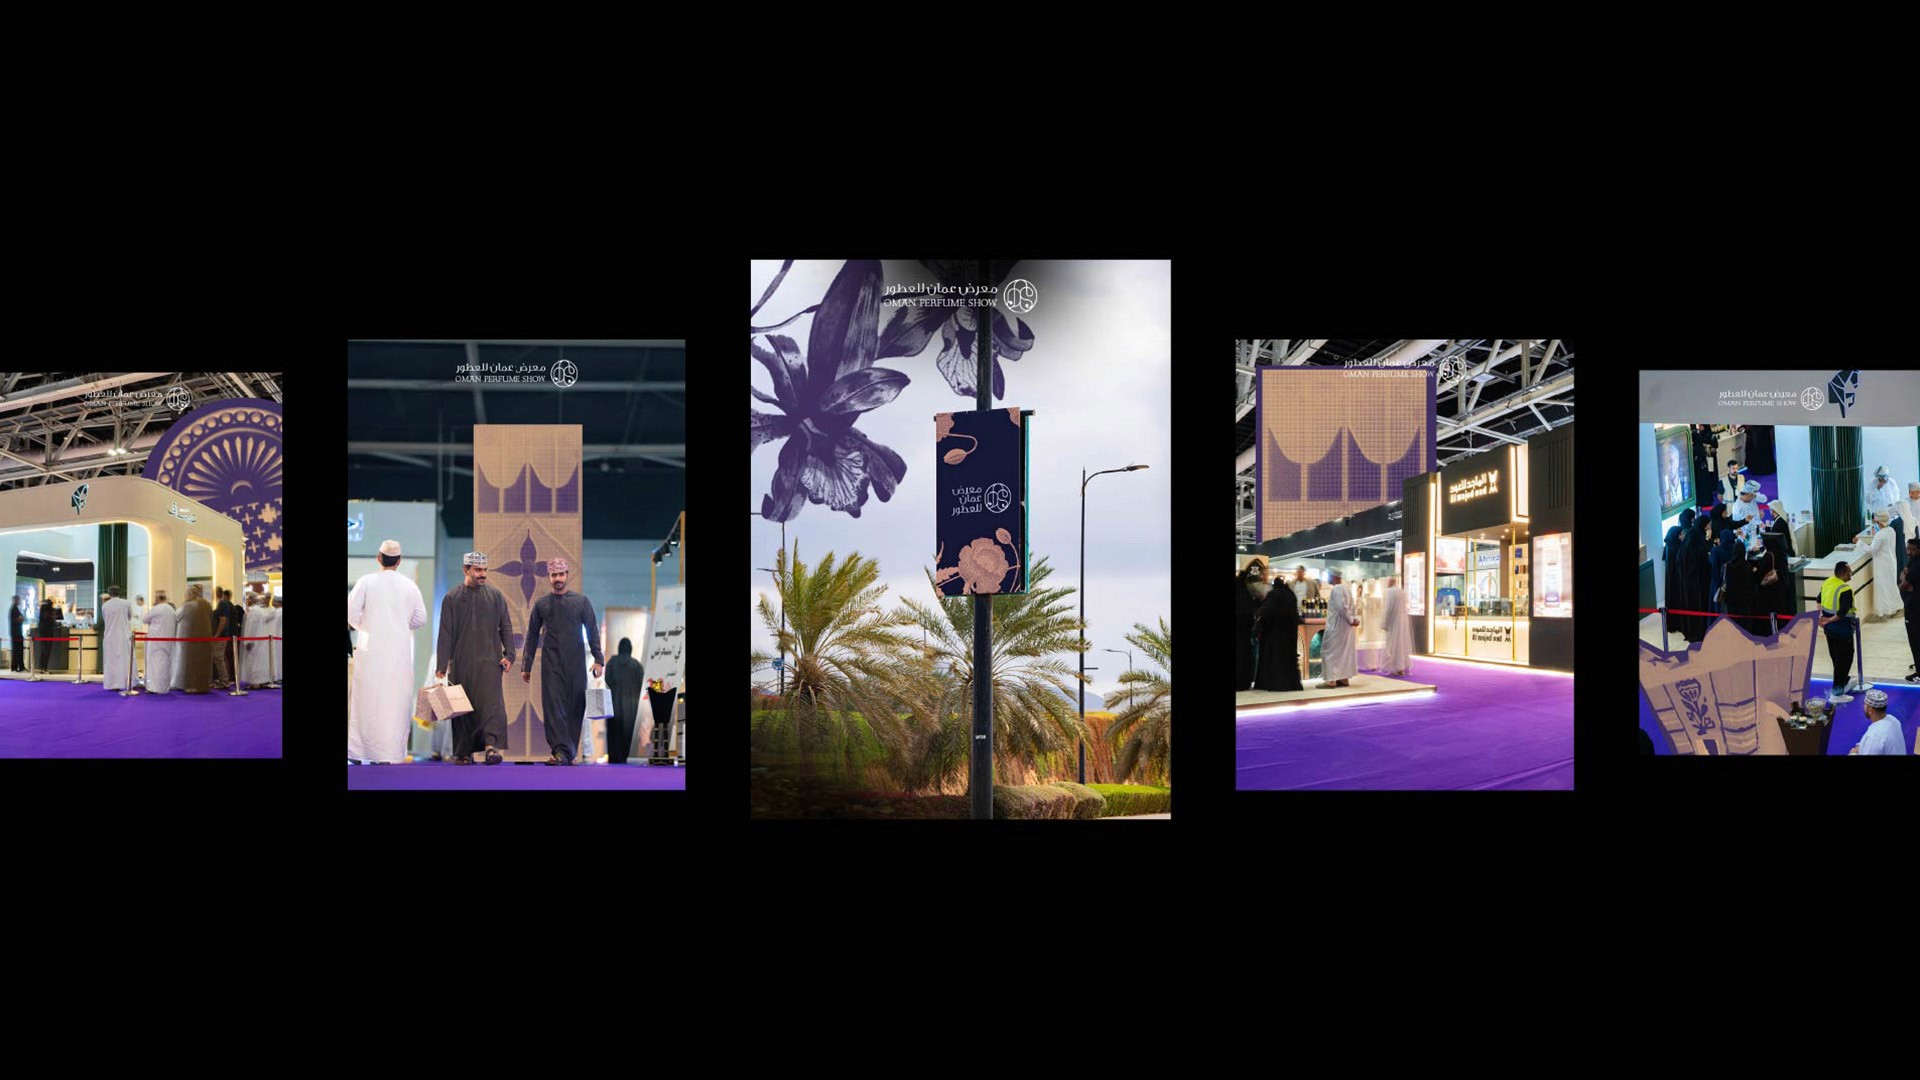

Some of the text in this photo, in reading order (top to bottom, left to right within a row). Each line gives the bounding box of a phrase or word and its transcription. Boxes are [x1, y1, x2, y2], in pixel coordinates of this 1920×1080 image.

[951, 485, 983, 496] معرض
[958, 494, 983, 505] عمان
[951, 503, 983, 517] للعطور
